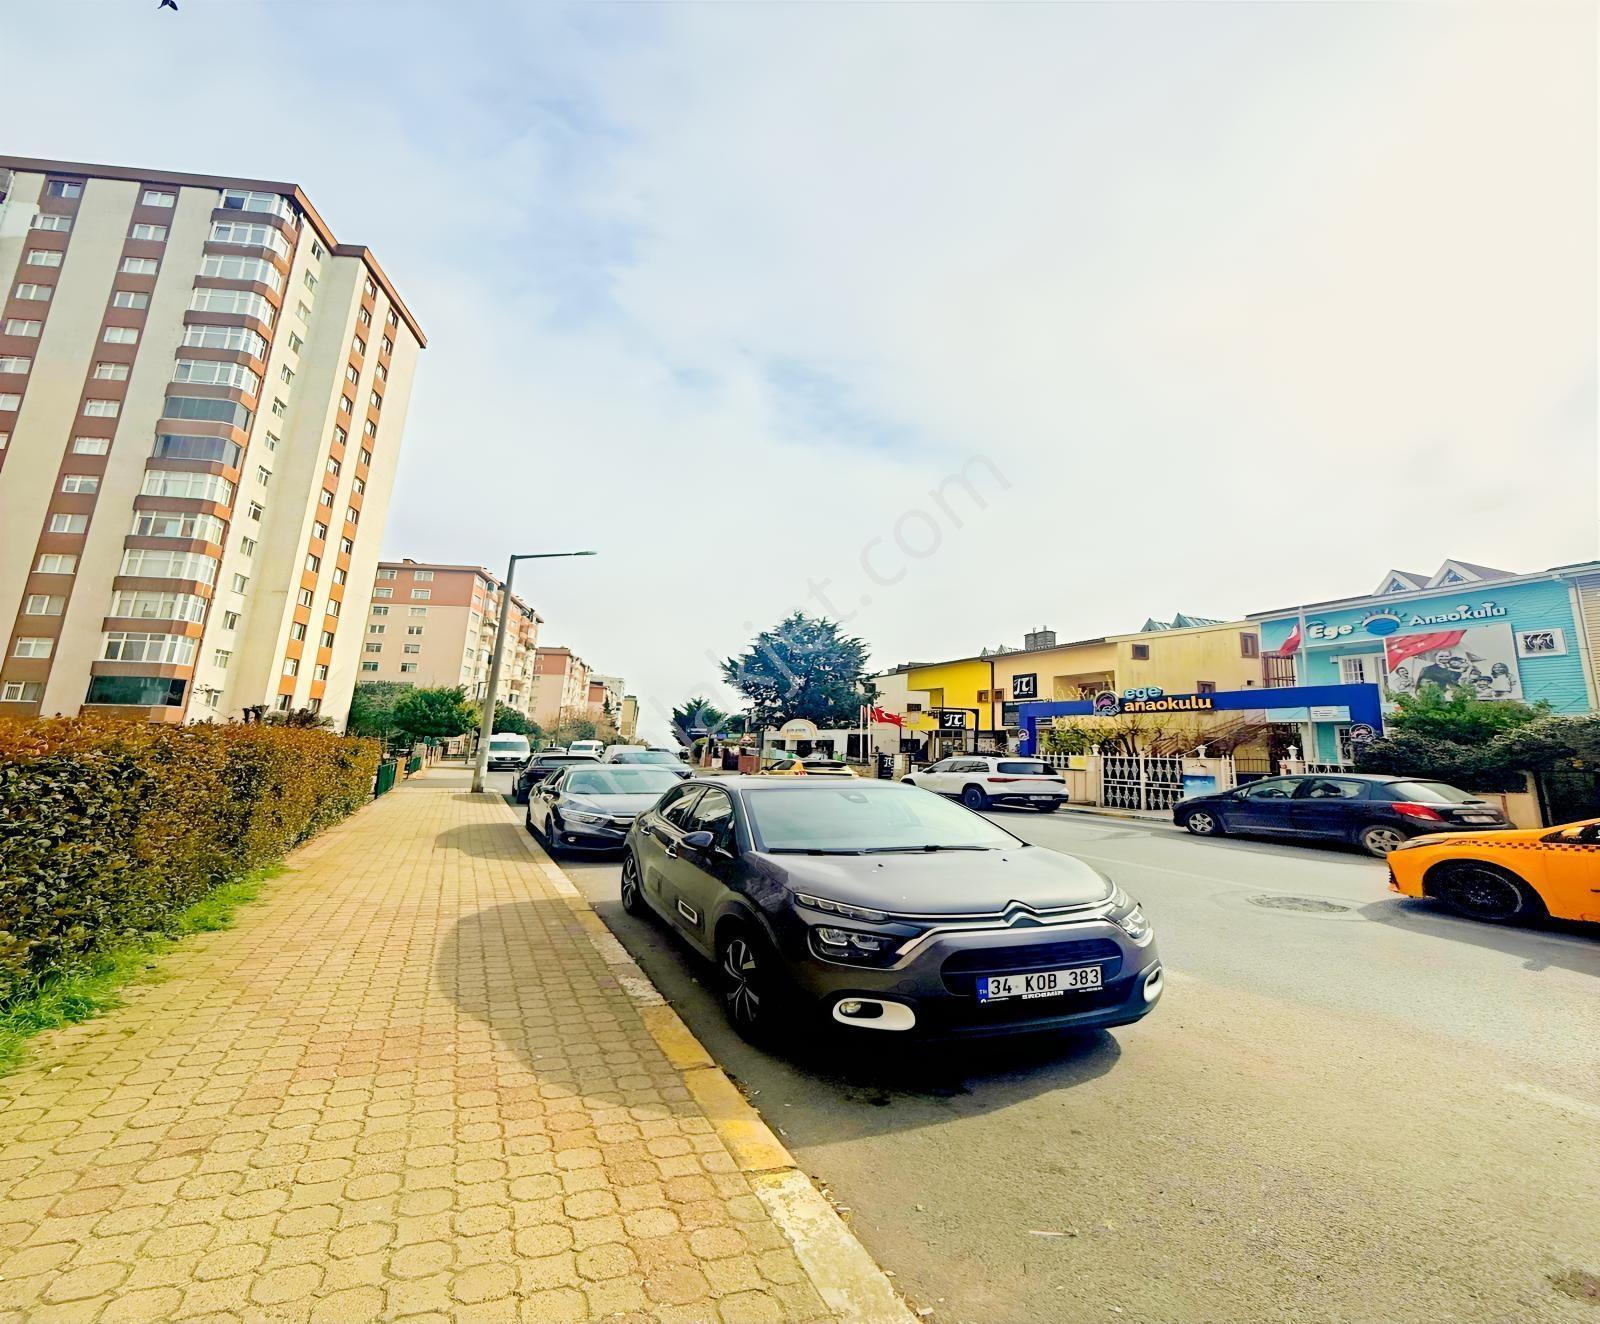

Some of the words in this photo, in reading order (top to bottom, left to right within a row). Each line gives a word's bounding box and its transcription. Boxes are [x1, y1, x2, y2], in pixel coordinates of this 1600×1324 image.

[1309, 622, 1353, 640] Ege
[1409, 602, 1507, 626] Anaokulu
[1124, 686, 1163, 701] ege
[1124, 696, 1212, 712] anaokulu
[990, 978, 1012, 995] 34
[1025, 973, 1057, 992] KOB
[1069, 969, 1099, 986] 383
